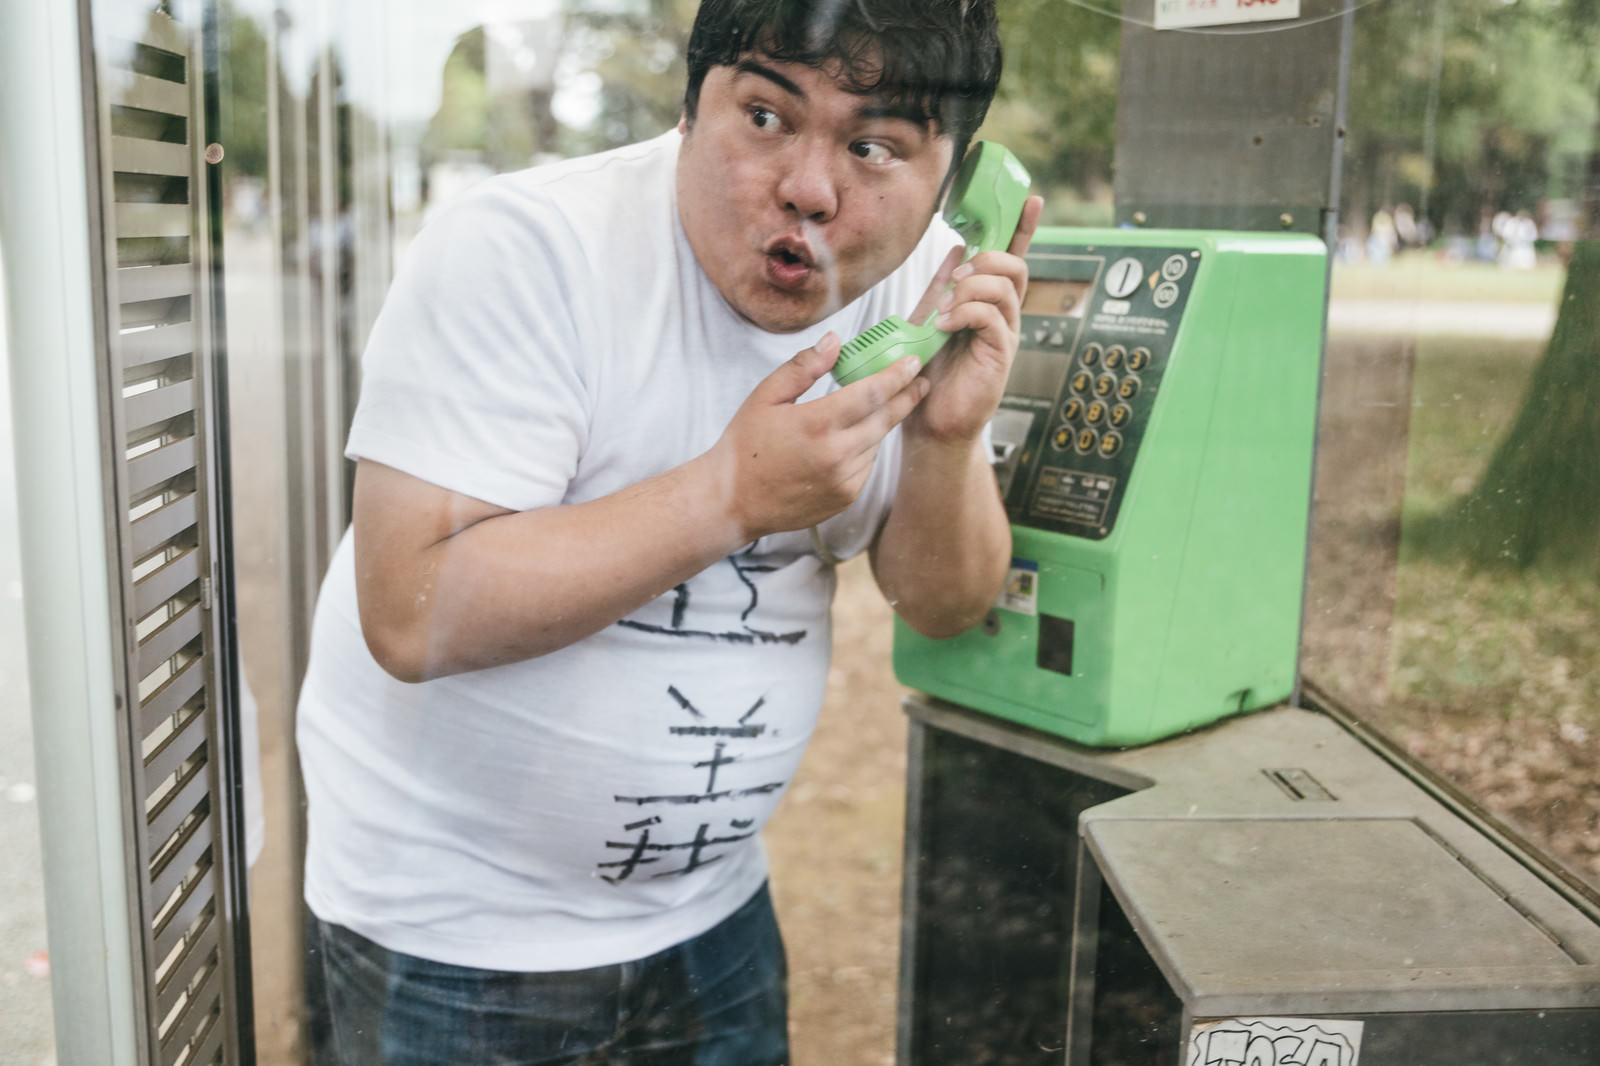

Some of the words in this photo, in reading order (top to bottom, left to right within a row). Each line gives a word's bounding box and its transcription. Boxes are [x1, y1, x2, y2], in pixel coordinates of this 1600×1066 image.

[1106, 349, 1118, 367] 2
[1129, 351, 1142, 369] 3
[1073, 375, 1086, 389] 4
[1097, 377, 1110, 394] 5
[1121, 379, 1132, 397] 6
[1066, 402, 1078, 419] 7
[1088, 403, 1102, 422] 8
[1112, 407, 1124, 424] 9
[1079, 430, 1092, 449] 0
